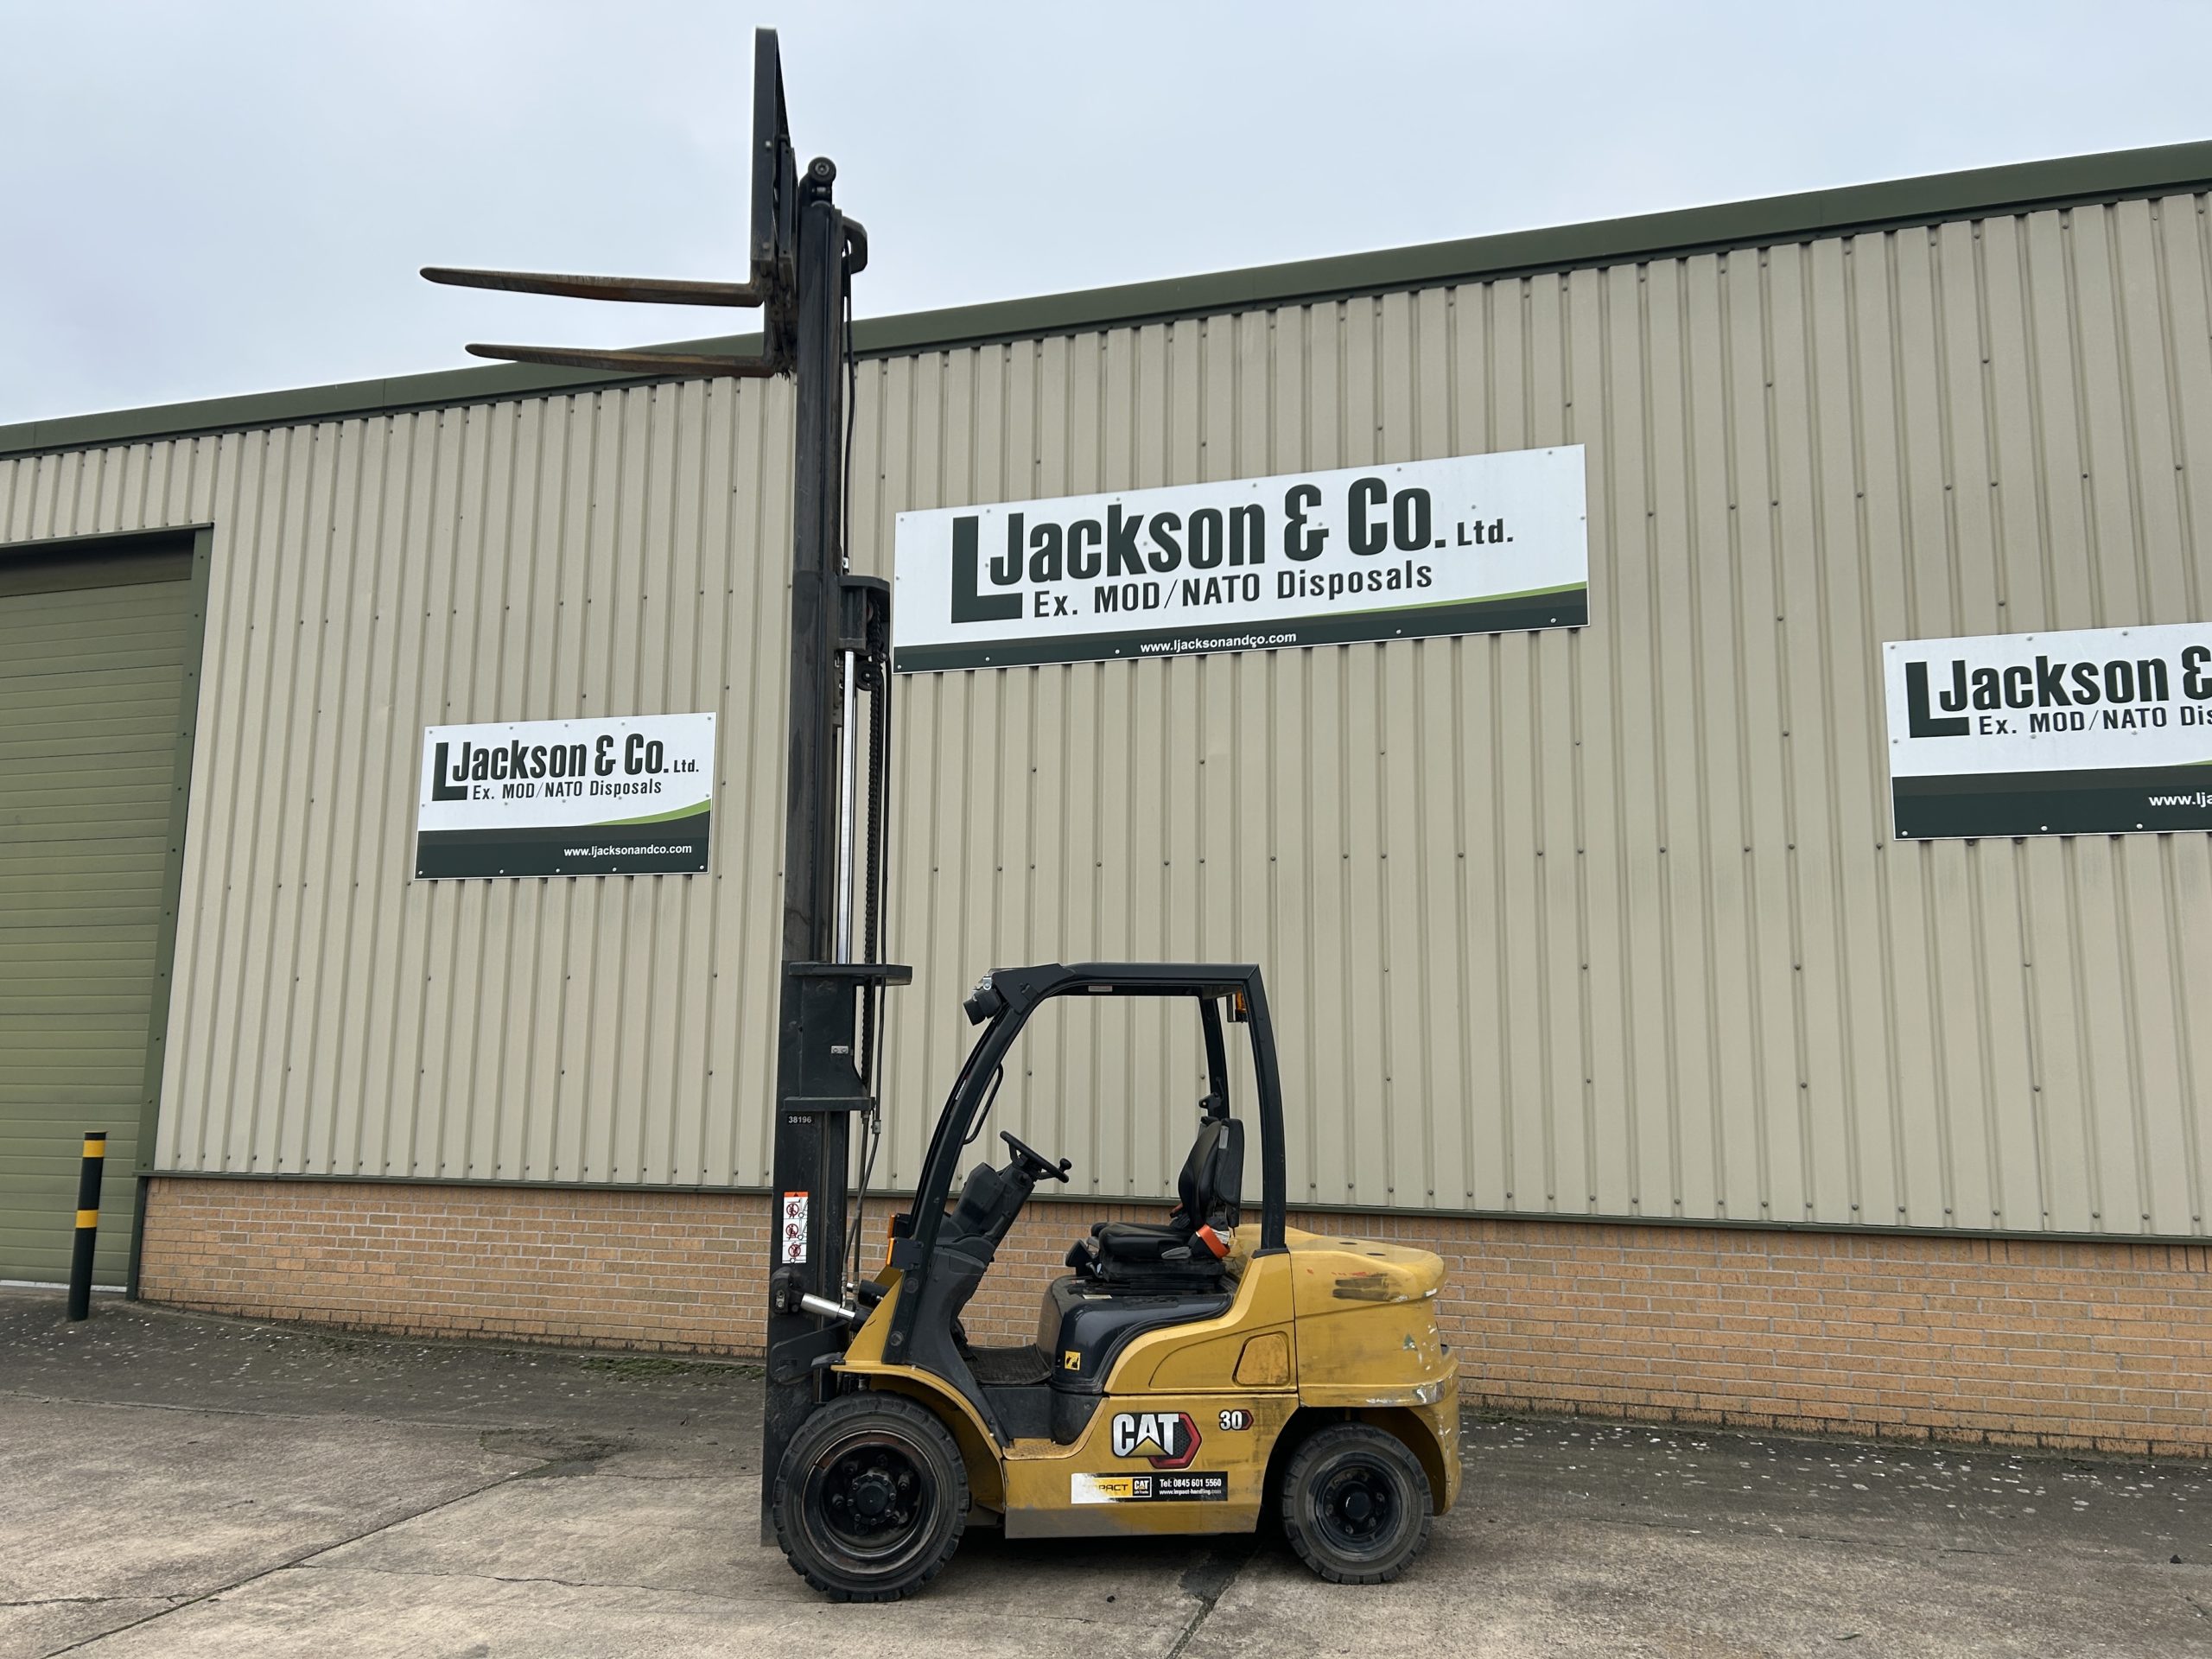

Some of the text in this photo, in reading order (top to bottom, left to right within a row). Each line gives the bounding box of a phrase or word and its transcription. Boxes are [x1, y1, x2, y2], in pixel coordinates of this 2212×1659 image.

[1284, 484, 1329, 562] &
[1348, 477, 1446, 556] Co.
[1457, 518, 1513, 546] Ltd.
[1034, 560, 1432, 618] Ex. MOD/NATO Disposals
[1141, 632, 1296, 653] www.ljacksonandco.com
[2181, 645, 2212, 701] &
[1979, 715, 2018, 735] Ex.
[2031, 707, 2167, 733] MOD/NATO
[594, 734, 616, 776] &
[624, 733, 670, 775] Co.
[673, 760, 699, 773] Ltd.
[473, 779, 662, 800] Ex. MOD/NATO Disposals
[563, 844, 692, 858] www.ljacksonandco.com
[1219, 1410, 1243, 1431] 30
[1112, 1413, 1179, 1458] CAT
[1134, 1480, 1149, 1491] CAT
[1159, 1478, 1222, 1488] Tel: 0845 601 5560
